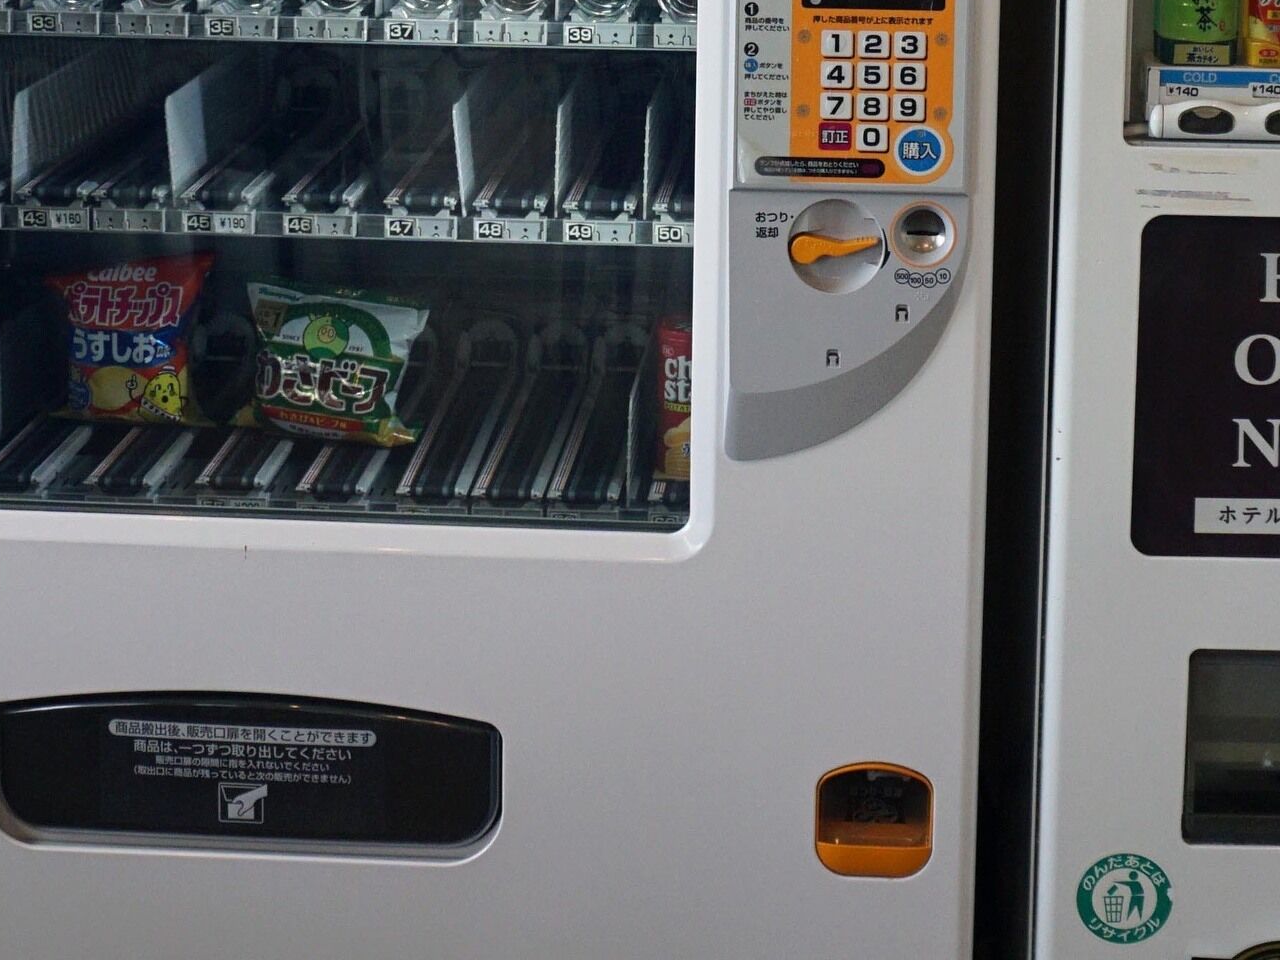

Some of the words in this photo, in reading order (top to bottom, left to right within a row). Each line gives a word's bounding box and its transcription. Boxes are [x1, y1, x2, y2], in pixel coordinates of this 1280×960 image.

[33, 16, 56, 30] 33
[210, 20, 233, 34] 35
[813, 15, 934, 26] 押した商品番号が上に表示されます
[390, 25, 413, 38] 37
[569, 28, 592, 42] 39
[831, 34, 840, 53] 1
[864, 34, 882, 54] 2
[901, 35, 918, 54] 3
[827, 65, 845, 84] 4
[864, 65, 881, 85] 5
[900, 66, 917, 85] 6
[1182, 71, 1217, 84] COLD
[1169, 85, 1199, 97] ¥140
[827, 97, 844, 115] 7
[863, 97, 881, 117] 8
[900, 97, 917, 117] 9
[822, 129, 849, 144] 訂正
[863, 127, 880, 147] 0
[903, 142, 937, 160] 購入
[24, 211, 47, 224] 43
[188, 215, 211, 230] 45
[289, 218, 312, 231] 46
[755, 212, 794, 223] おつり・
[390, 220, 414, 234] 47
[478, 222, 502, 236] 48
[570, 225, 592, 239] 49
[659, 227, 682, 240] 50
[755, 226, 779, 238] 返却
[66, 281, 184, 328] ポテトチップス
[255, 348, 391, 415] わさビーフ
[114, 720, 372, 745] 商品搬出後、販売口扉を開くことができます
[133, 739, 352, 760] 商品は、一つずつ取り出してください
[1082, 854, 1167, 893] のんだあとは
[1088, 916, 1161, 942] リサイクル
